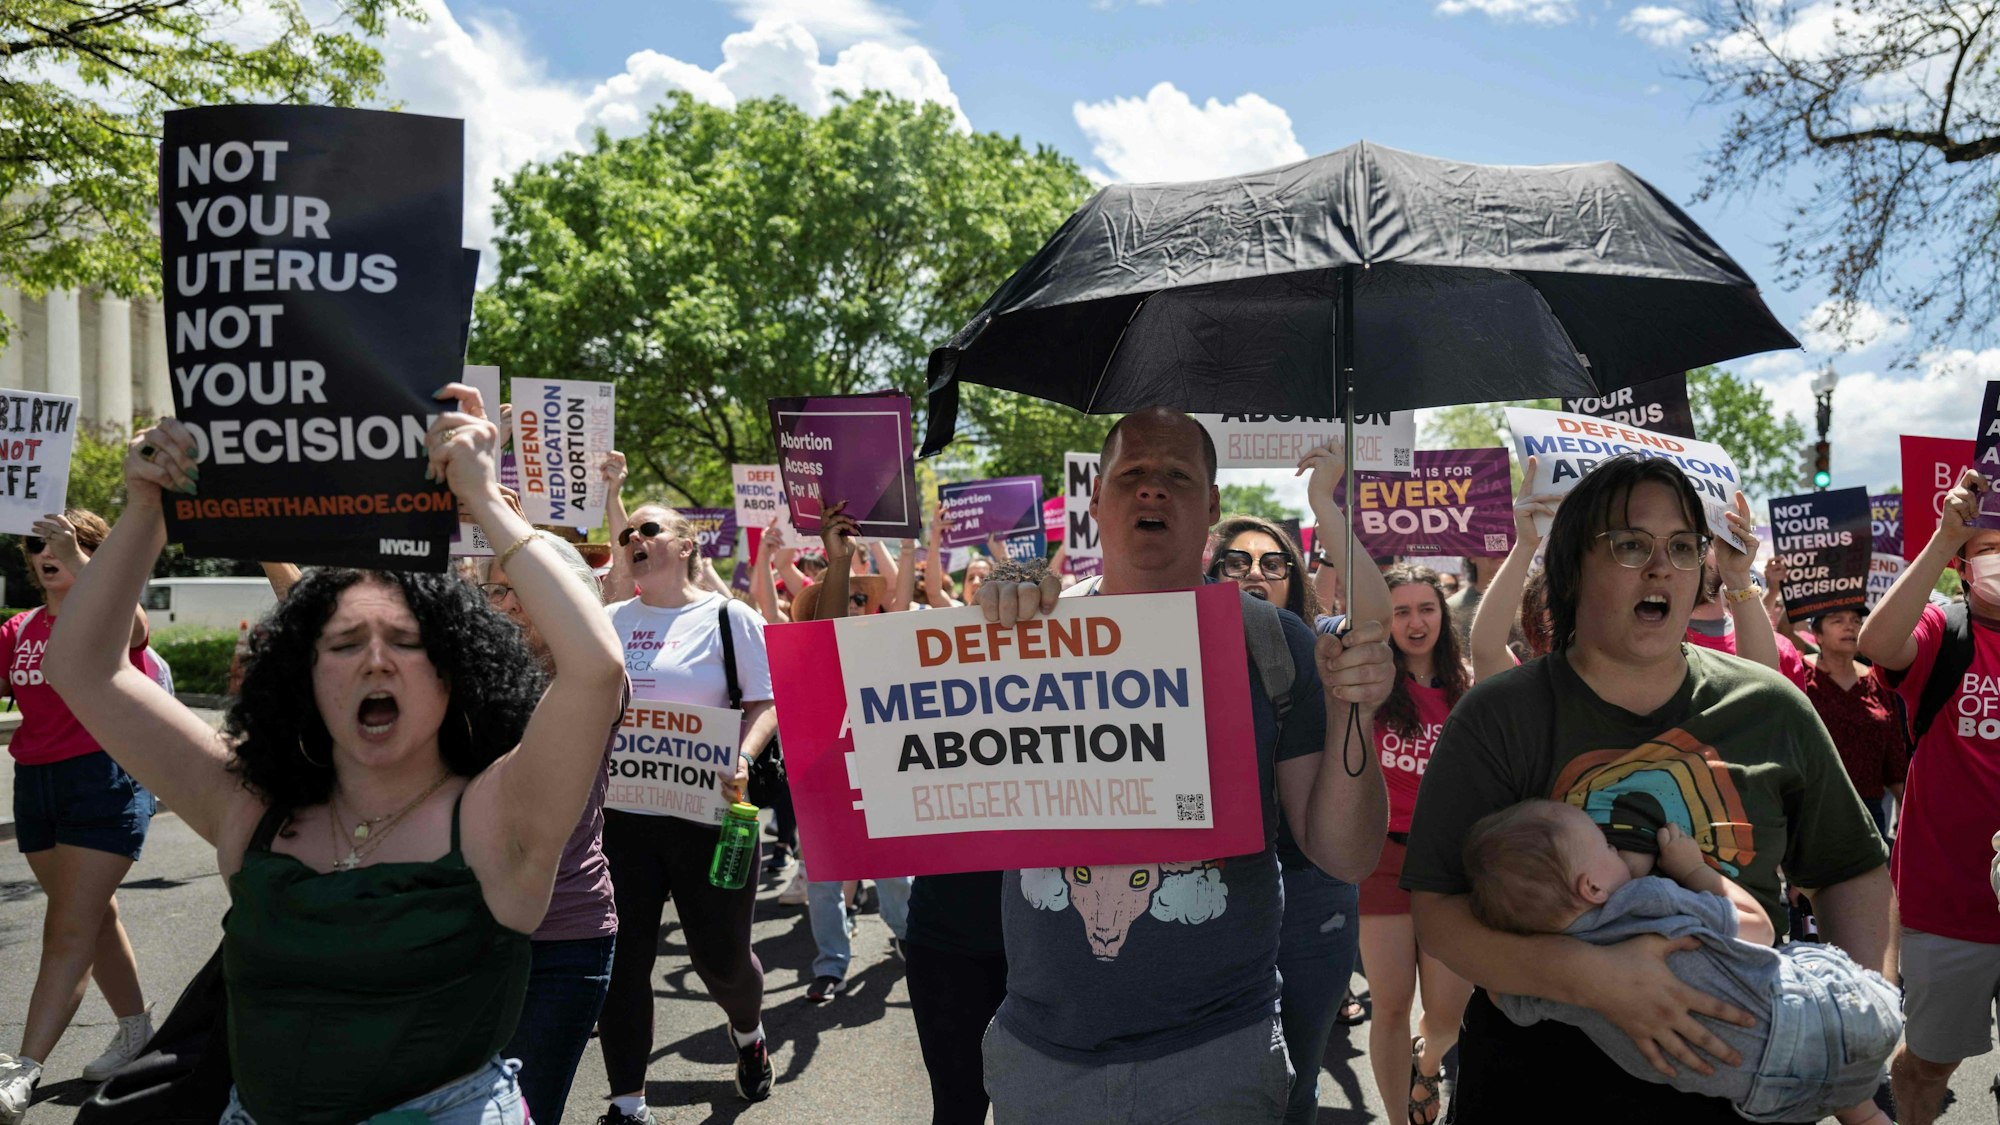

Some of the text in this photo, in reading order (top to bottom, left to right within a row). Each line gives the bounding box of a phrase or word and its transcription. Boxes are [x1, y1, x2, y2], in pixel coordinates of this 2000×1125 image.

[178, 141, 288, 188] NOT
[176, 194, 331, 243] YOUR
[176, 248, 398, 297] UTERUS
[176, 304, 284, 354] NOT
[176, 360, 327, 408] YOUR
[1567, 387, 1633, 414] YOUR
[780, 431, 833, 450] Abortion
[1228, 433, 1303, 460] BIGGER
[1356, 435, 1382, 461] ROE
[1557, 418, 1685, 453] DEFEND
[520, 410, 544, 494] DEFEND
[543, 385, 566, 519] MEDICATION
[567, 398, 587, 511] ABORTION
[785, 457, 824, 476] Access
[1426, 467, 1439, 478] IS
[1444, 466, 1472, 477] FOR
[789, 481, 805, 497] For
[942, 494, 991, 508] Abortion
[1360, 479, 1472, 509] EVERY
[176, 491, 453, 520] BIGGERTHANROE.COM
[943, 507, 984, 520] Access
[1774, 503, 1813, 519] NOT
[965, 518, 979, 529] All
[1361, 506, 1475, 535] BODY
[1776, 516, 1829, 534] YOUR
[379, 538, 431, 557] NYCLU
[1778, 531, 1853, 551] UTERUS
[1783, 576, 1863, 601] DECISION
[627, 640, 680, 651] WON'T
[632, 631, 656, 640] WE
[916, 616, 1121, 668] DEFEND
[860, 667, 1189, 724] MEDICATION
[898, 722, 1166, 772] ABORTION
[647, 786, 682, 811] THAN
[684, 792, 707, 815] ROE
[912, 777, 1157, 823] BIGGER THAN ROE
